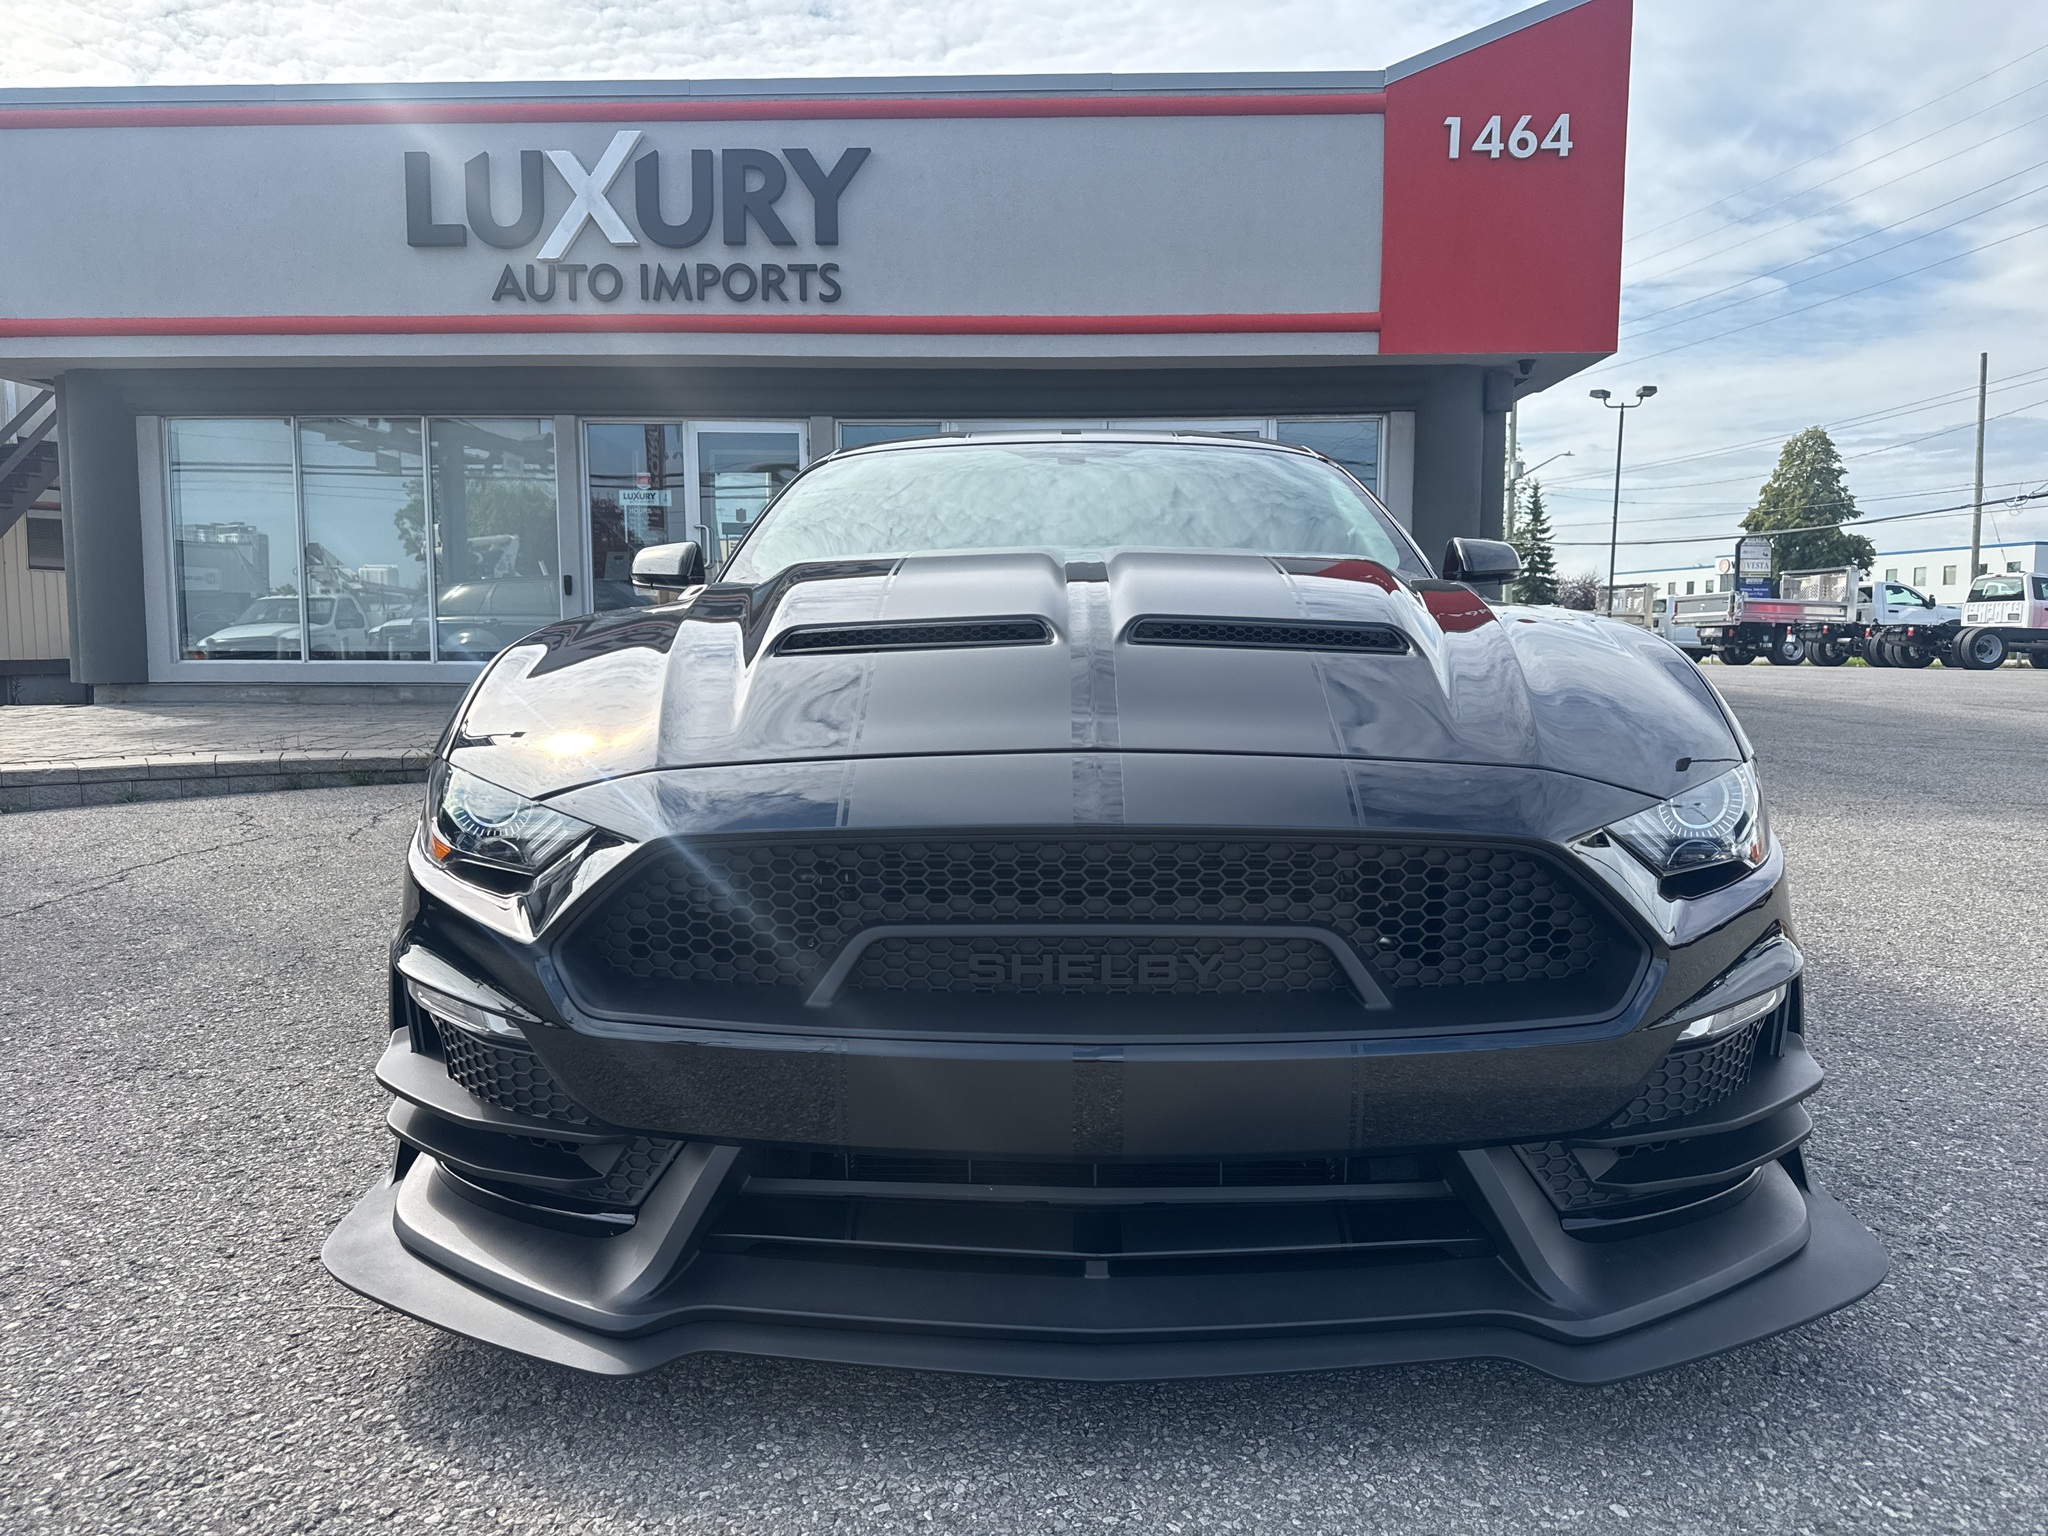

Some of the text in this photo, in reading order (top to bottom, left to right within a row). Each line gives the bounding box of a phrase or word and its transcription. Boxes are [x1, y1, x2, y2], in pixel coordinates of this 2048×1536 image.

[1442, 113, 1573, 159] 1464
[404, 130, 871, 262] LUXURY
[491, 262, 842, 302] AUTO IMPORTS
[623, 491, 657, 501] LUXURY
[1746, 561, 1769, 570] VESTA
[968, 953, 1225, 985] SHELBY
